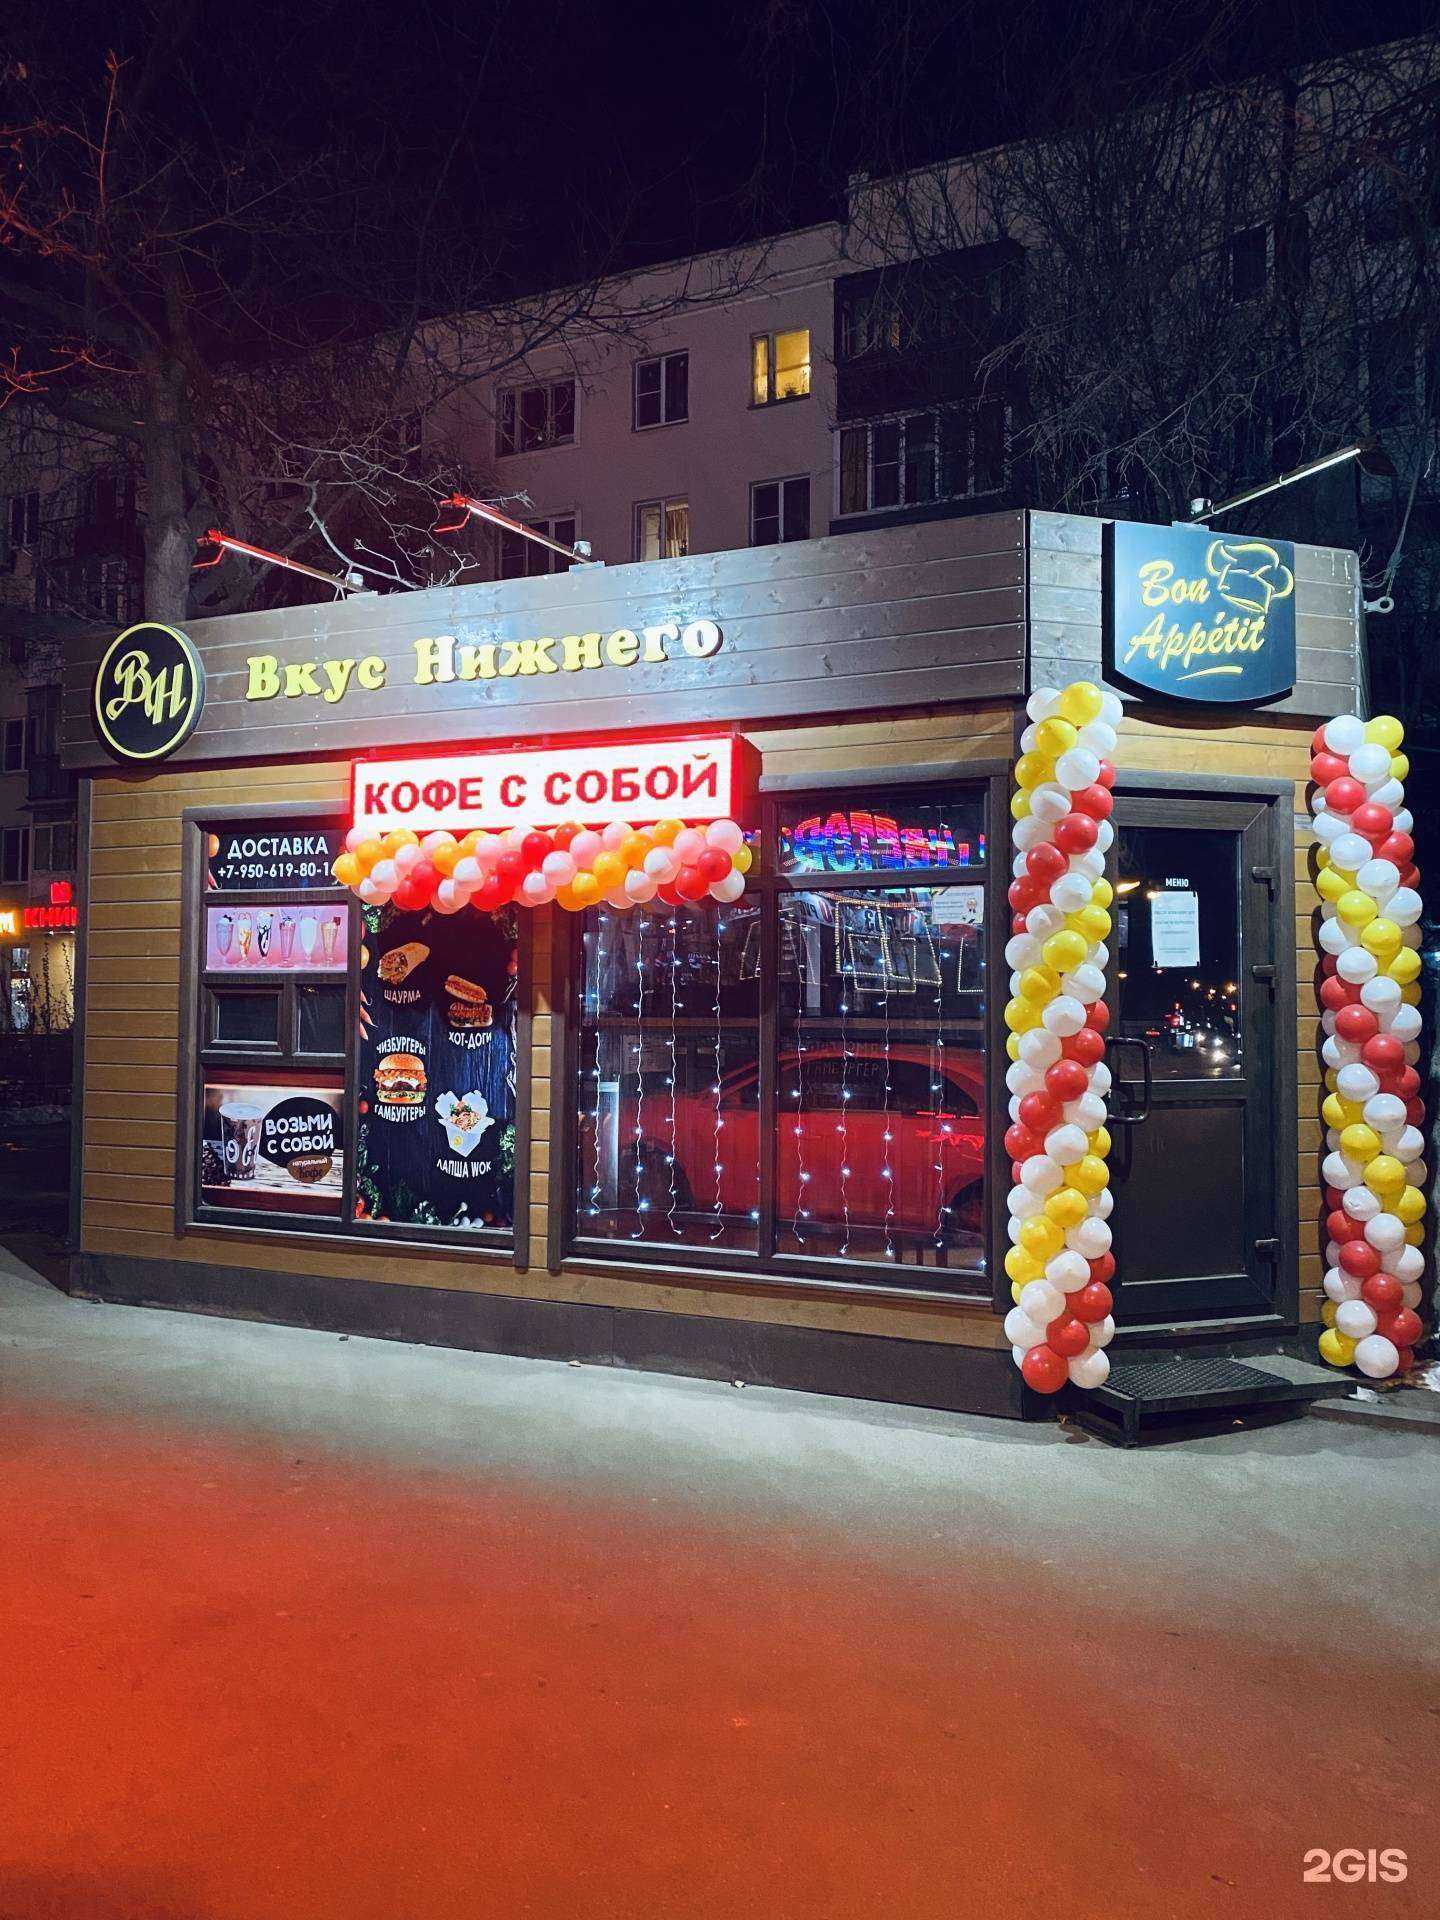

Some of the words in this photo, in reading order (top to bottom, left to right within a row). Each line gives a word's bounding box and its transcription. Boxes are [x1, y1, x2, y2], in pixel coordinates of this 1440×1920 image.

[1138, 559, 1211, 607] Bon
[1123, 611, 1265, 670] Appétit
[246, 654, 386, 703] Вкус
[413, 619, 723, 686] Нижнего
[363, 776, 484, 815] КОФЕ
[499, 774, 528, 808] С
[543, 752, 719, 806] СОБОЙ
[227, 836, 329, 859] ДОСТАВКА
[217, 861, 333, 879] +7-950-619-80-1
[1165, 878, 1189, 887] МЕНЮ
[383, 989, 421, 1004] ШАУРМА
[376, 1036, 426, 1055] ЧИЗБУРГЕРЫ
[448, 1031, 492, 1050] ХОТ-ДОГИ
[374, 1104, 426, 1122] ГАМБУРГЕРЫ
[265, 1113, 333, 1135] ВОЗЬМИ
[267, 1139, 278, 1154] С
[280, 1130, 334, 1153] СОБОЙ
[436, 1158, 469, 1178] ЛАПША
[471, 1161, 492, 1178] WOK
